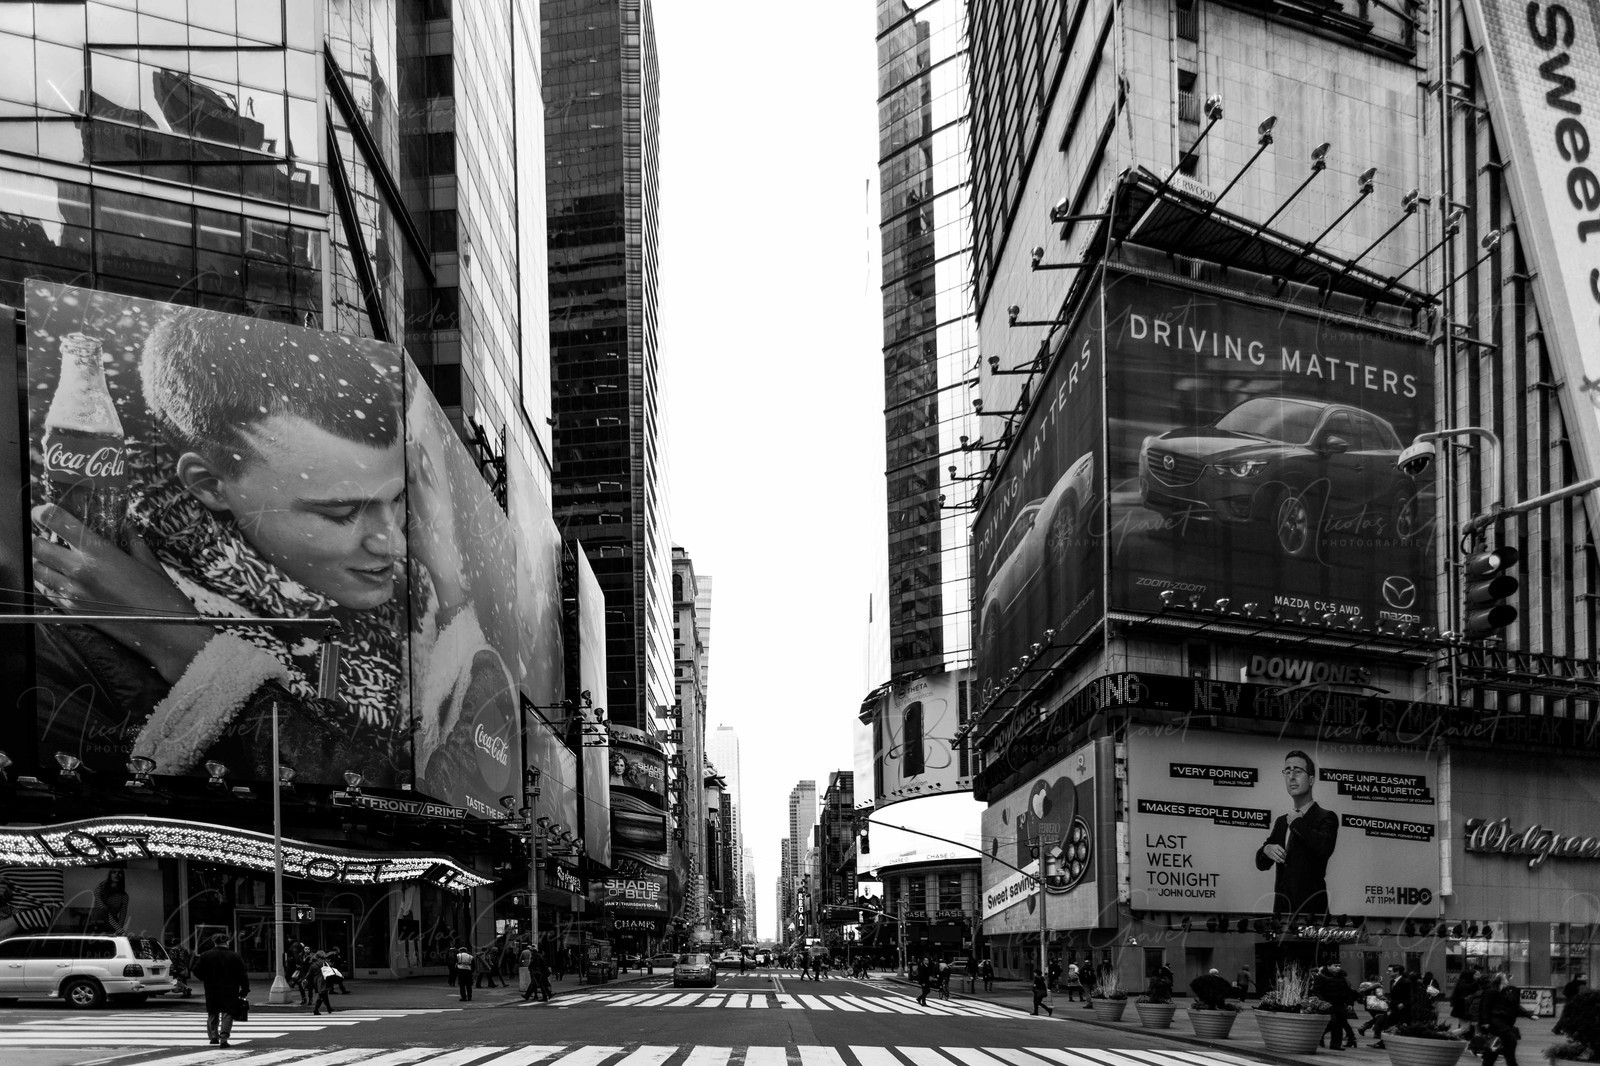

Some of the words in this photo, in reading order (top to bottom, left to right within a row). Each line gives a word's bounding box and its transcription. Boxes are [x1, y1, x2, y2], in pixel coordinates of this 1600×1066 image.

[1130, 313, 1265, 366] DRIVING
[1281, 347, 1417, 398] MATTERS
[978, 480, 1019, 560] DRIVING
[1021, 339, 1091, 479] MATTERS
[1135, 577, 1207, 593] zoom-zoom
[1274, 595, 1310, 610] MAZDA
[1313, 600, 1336, 613] CX-5
[1339, 603, 1361, 616] AWD
[1379, 610, 1420, 624] mazda
[1194, 680, 1242, 713] NEW
[1344, 783, 1370, 793] THAN
[1372, 785, 1379, 793] A
[1356, 775, 1417, 786] UNPLEASANT
[427, 806, 464, 818] PRIME
[466, 795, 485, 814] TASTE
[485, 805, 497, 819] THE
[1188, 806, 1229, 818] PEOPLE
[35, 831, 153, 860] LOFT
[1146, 834, 1187, 849] LAST
[1147, 852, 1193, 868] WEEK
[604, 879, 661, 892] SHADES
[1146, 871, 1219, 887] TONIGHT
[608, 888, 624, 897] OF
[625, 889, 658, 901] BLUE
[987, 886, 1008, 909] Sweet
[1158, 888, 1183, 897] JOHN
[1185, 889, 1216, 898] OLIVER
[1365, 885, 1383, 895] FEB
[1385, 886, 1395, 895] 14
[1397, 887, 1432, 905] HBO
[1365, 896, 1376, 904] AT
[1378, 896, 1396, 904] 11PM
[614, 919, 655, 930] CHAMPS
